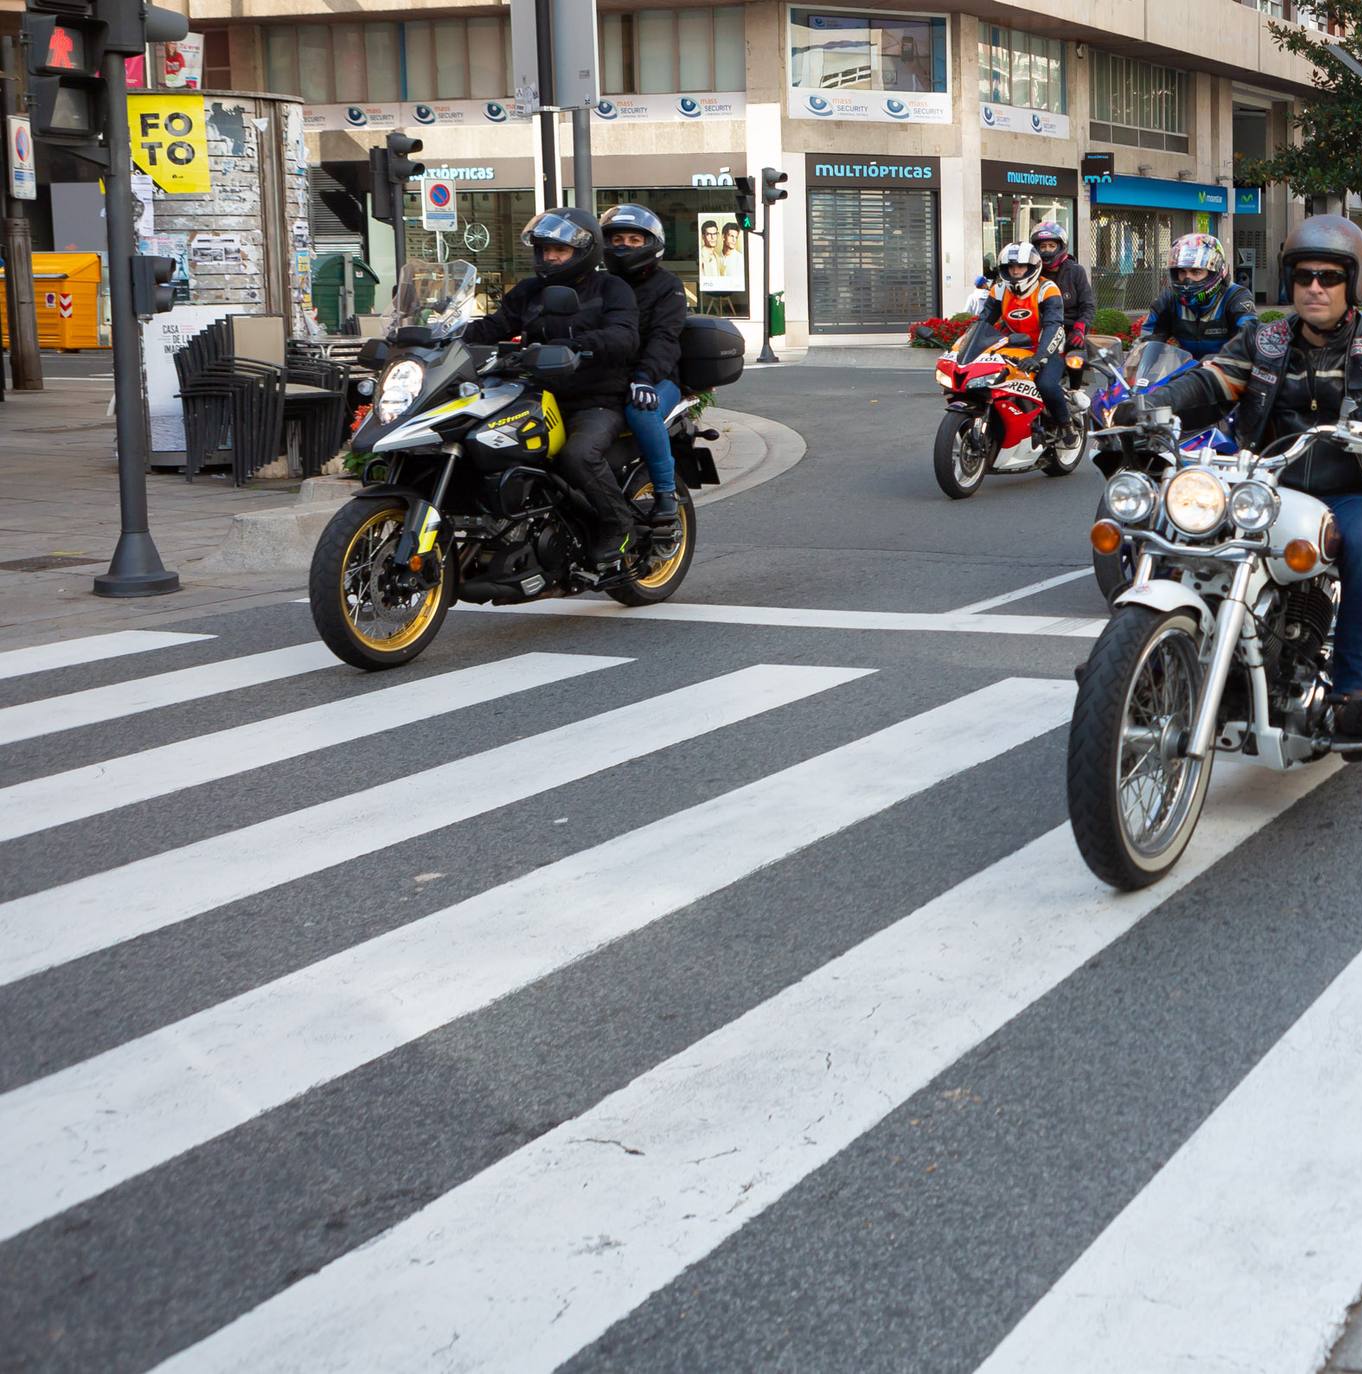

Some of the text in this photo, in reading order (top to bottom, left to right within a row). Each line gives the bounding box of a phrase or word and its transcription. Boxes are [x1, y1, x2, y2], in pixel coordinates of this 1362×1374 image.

[704, 104, 732, 112] SECURITY
[913, 107, 944, 115] SECURITY
[139, 112, 193, 137] FO
[141, 141, 195, 166] TO
[162, 325, 179, 334] CASA
[173, 335, 180, 344] DE
